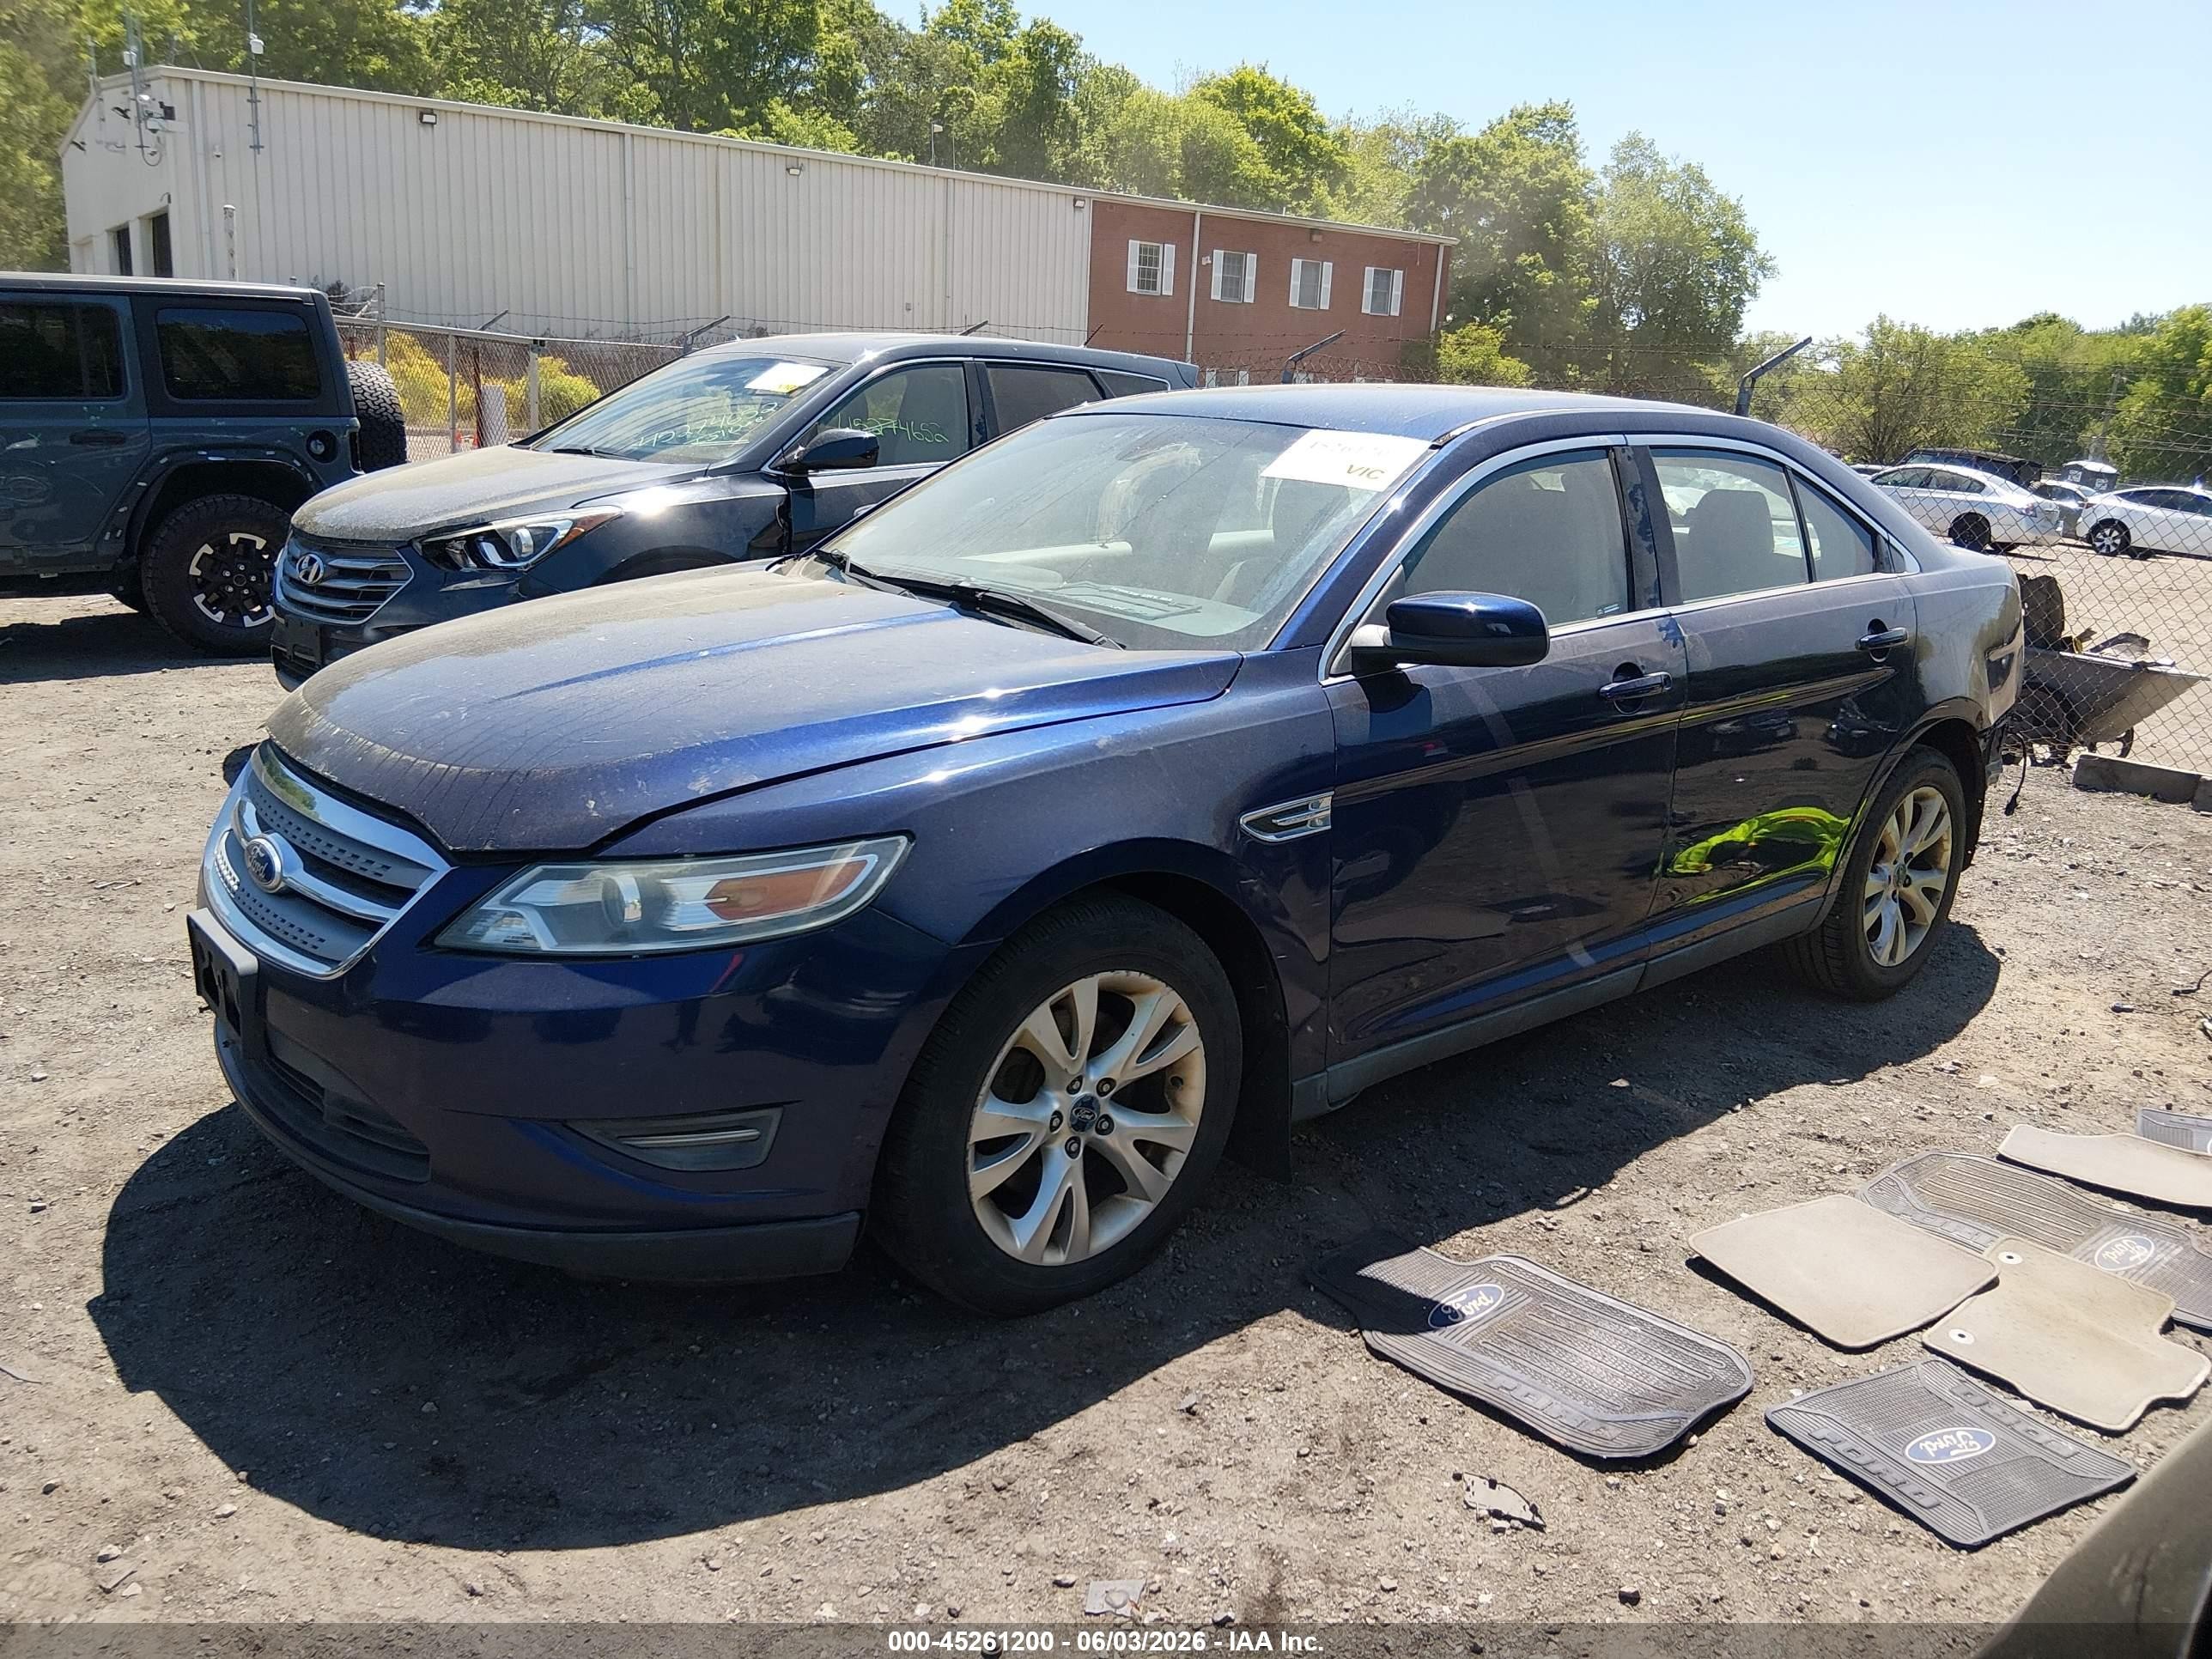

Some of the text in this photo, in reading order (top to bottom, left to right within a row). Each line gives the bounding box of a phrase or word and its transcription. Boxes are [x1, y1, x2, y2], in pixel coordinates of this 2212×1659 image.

[1346, 464, 1385, 480] VIC
[246, 842, 270, 880] Ford
[1075, 1108, 1096, 1121] Ford
[2101, 1239, 2148, 1265] Ford
[1441, 1290, 1494, 1322] Ford
[1919, 1430, 1982, 1457] Ford
